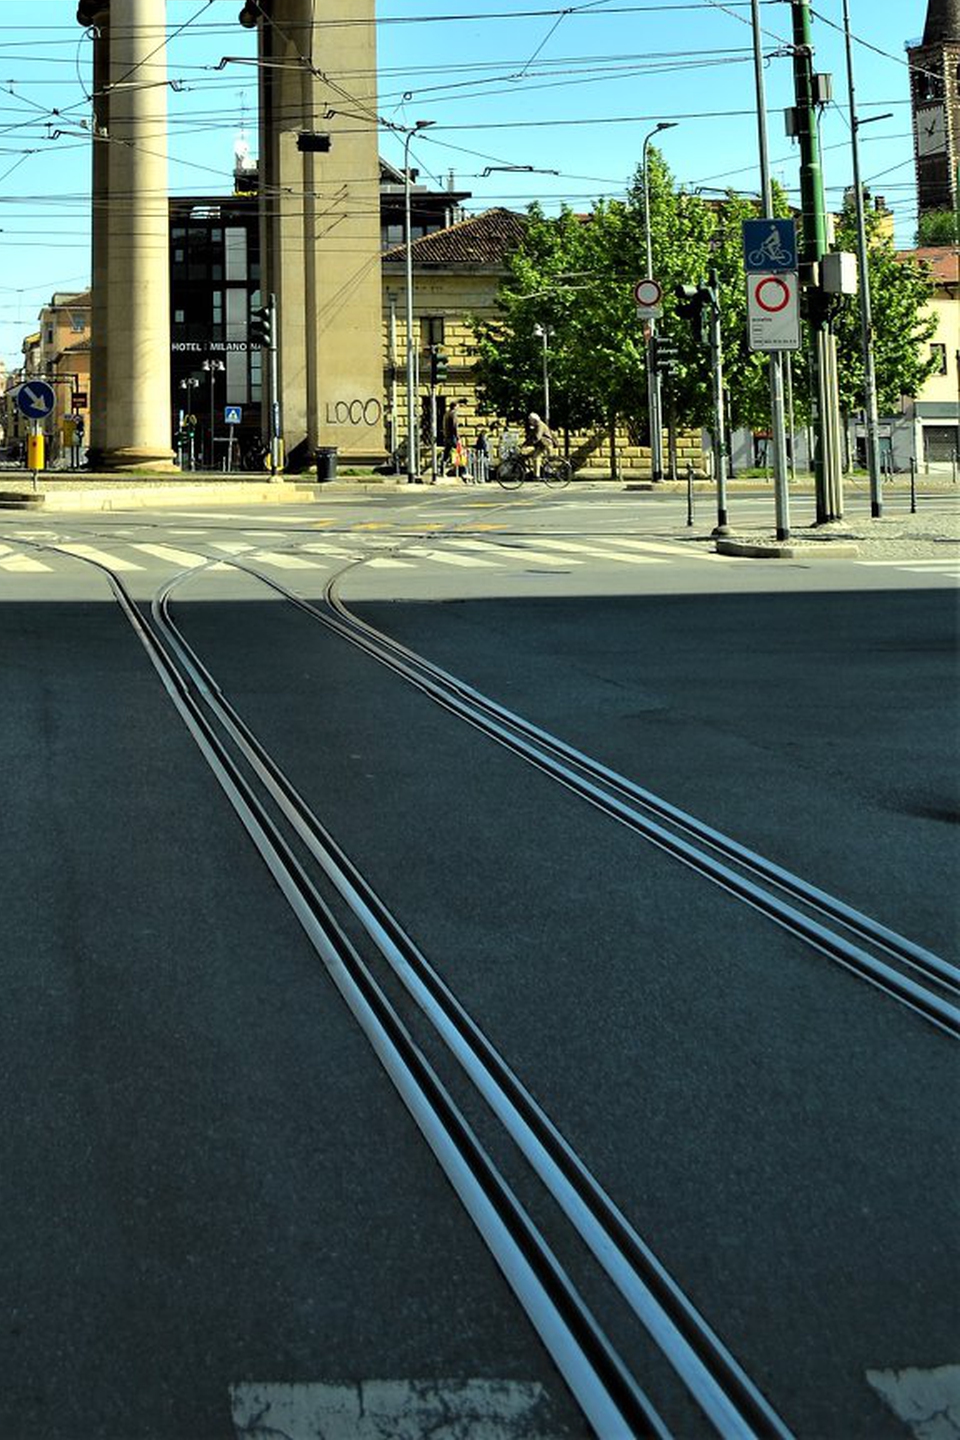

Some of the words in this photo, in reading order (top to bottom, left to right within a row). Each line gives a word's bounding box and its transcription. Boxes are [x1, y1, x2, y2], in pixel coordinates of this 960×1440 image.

[171, 342, 202, 352] HOTEL
[209, 342, 248, 351] MILANO
[325, 397, 382, 427] LOCO
